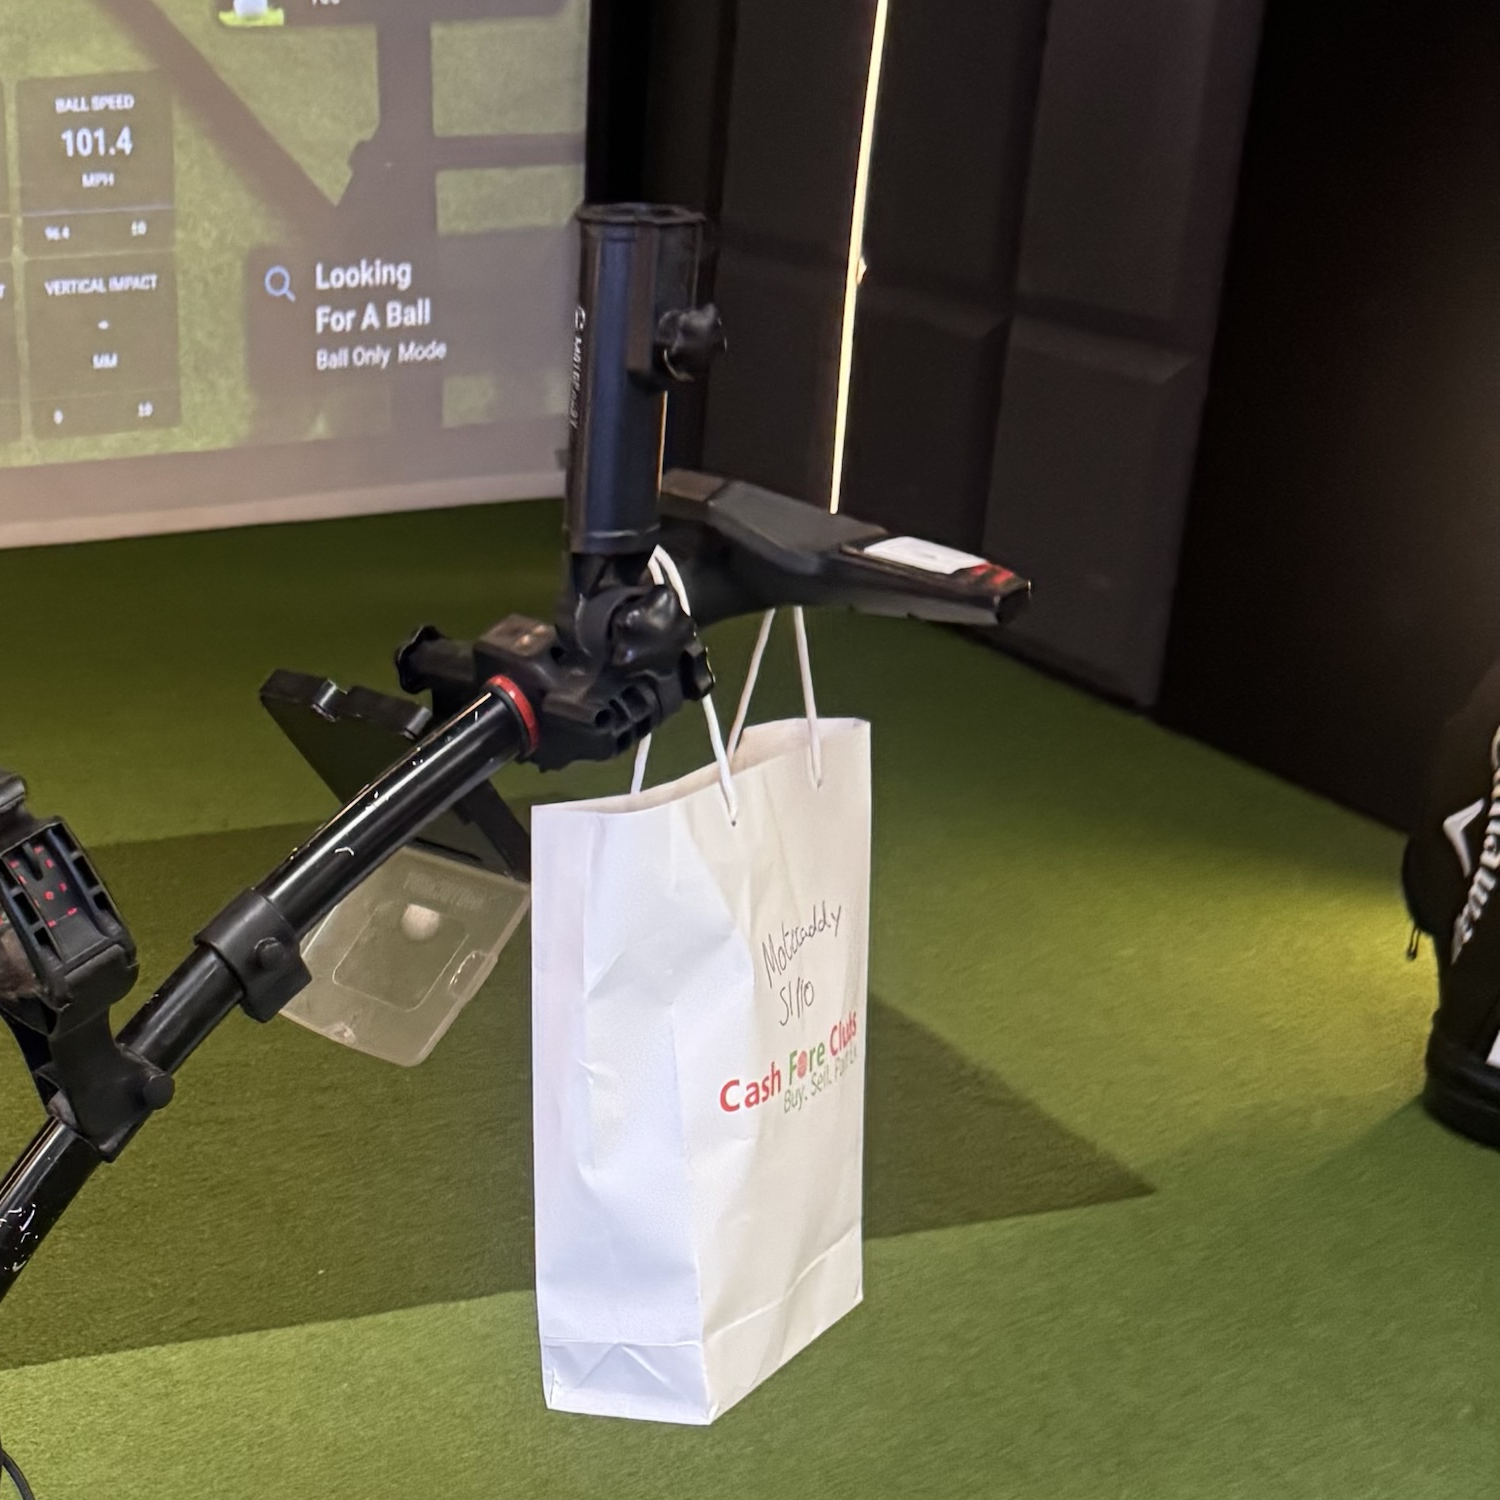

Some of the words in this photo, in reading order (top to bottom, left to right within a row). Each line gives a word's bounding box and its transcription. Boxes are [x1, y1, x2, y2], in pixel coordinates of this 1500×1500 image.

[54, 96, 90, 114] BALL
[91, 94, 135, 110] SPEED
[61, 126, 133, 157] 101.4
[81, 172, 114, 188] MPH
[44, 277, 106, 296] VERTICAL
[108, 274, 158, 293] IMPACT
[315, 258, 412, 290] Looking
[315, 305, 355, 334] For
[360, 302, 380, 330] A
[386, 298, 431, 328] Ball
[316, 346, 348, 370] Ball
[352, 344, 390, 370] Only
[397, 339, 447, 364] Mode
[720, 1061, 782, 1112] Cash
[789, 1042, 825, 1086] Fore
